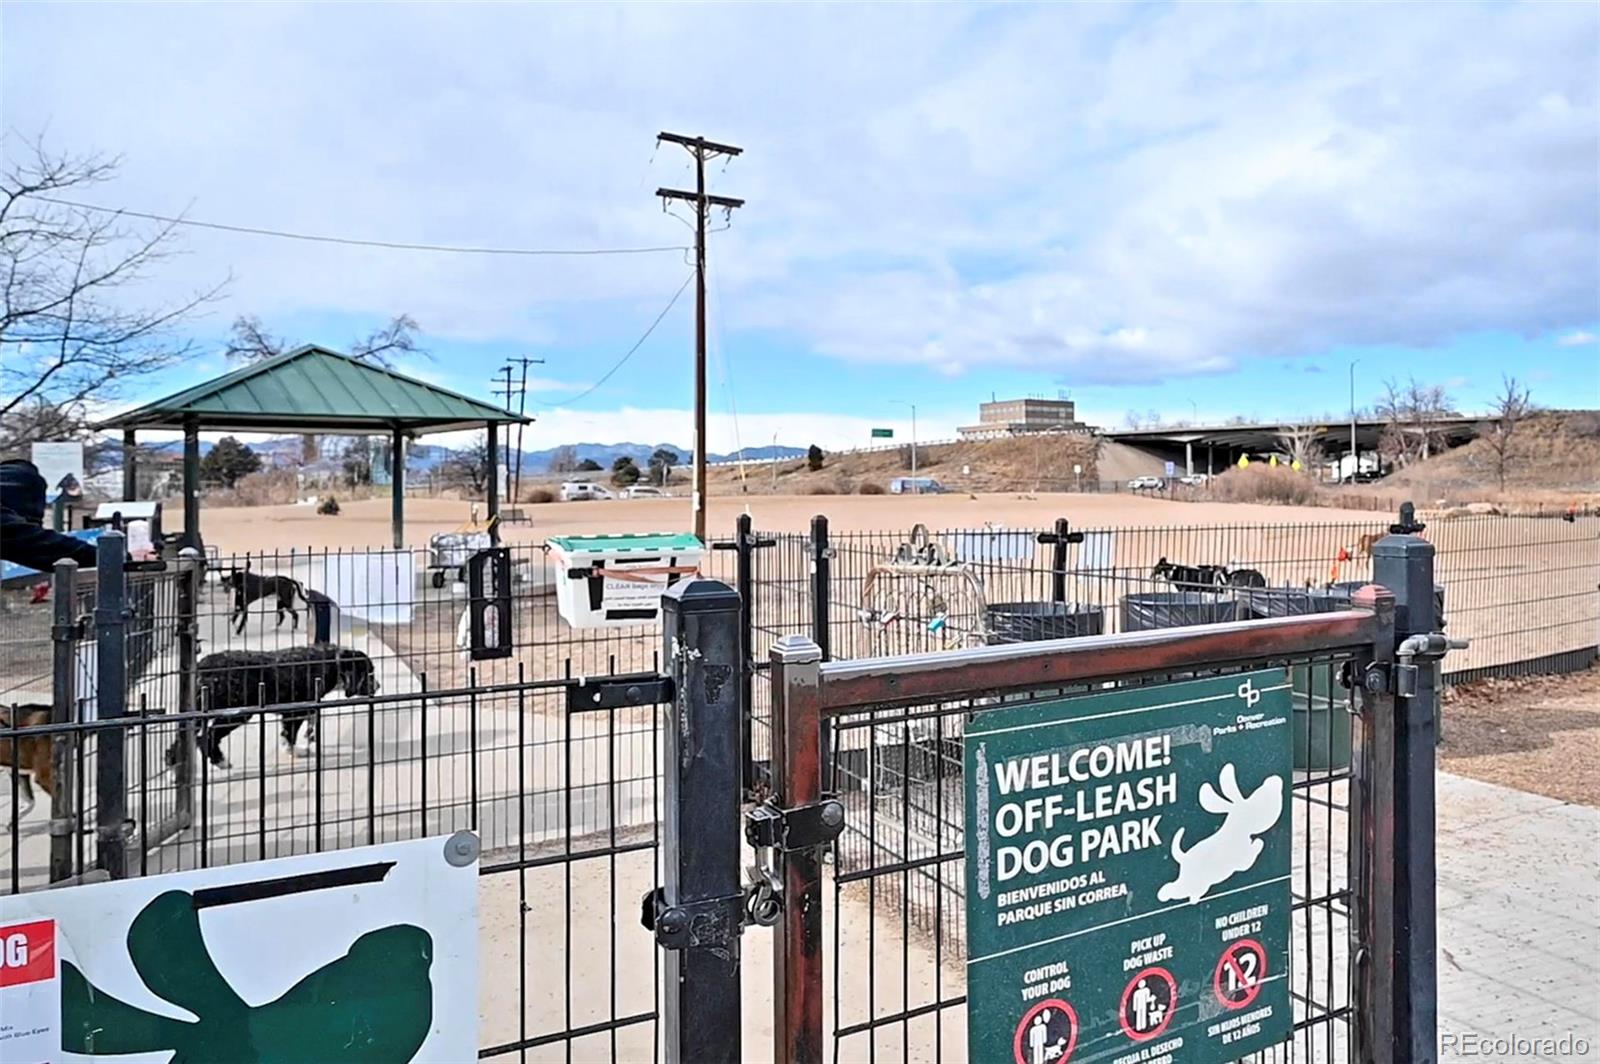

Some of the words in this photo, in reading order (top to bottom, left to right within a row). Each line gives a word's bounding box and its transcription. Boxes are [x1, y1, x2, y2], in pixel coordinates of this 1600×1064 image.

[1213, 725, 1237, 736] Parks
[1245, 717, 1287, 730] Recreation
[994, 735, 1172, 795] WELCOME!
[995, 773, 1177, 837] OFF-LEASH
[997, 834, 1073, 881] DOG
[1081, 815, 1162, 860] PARK
[997, 875, 1087, 907] BIENVENIDOS
[1089, 871, 1106, 886] AL
[997, 901, 1053, 926] PARQUE
[1054, 895, 1076, 912] SIN
[1078, 883, 1128, 906] CORREA
[1215, 915, 1228, 929] NO
[1228, 904, 1269, 925] CHILDREN
[1131, 937, 1153, 954] PICK
[1153, 933, 1166, 947] UP
[1222, 923, 1250, 941] UNDER
[1251, 920, 1262, 933] 12
[0, 932, 29, 968] G
[1123, 955, 1143, 972] DOG
[1143, 946, 1173, 965] WASTE
[1024, 960, 1069, 984] CONTROL
[1021, 982, 1049, 1001] YOUR
[1050, 975, 1071, 993] DOG
[1207, 1023, 1220, 1037] SIN
[1240, 1005, 1273, 1025] MENORES
[1141, 1048, 1151, 1060] EL
[1150, 1037, 1183, 1057] DESECHO
[1222, 1032, 1233, 1045] DE
[1232, 1030, 1242, 1041] 12
